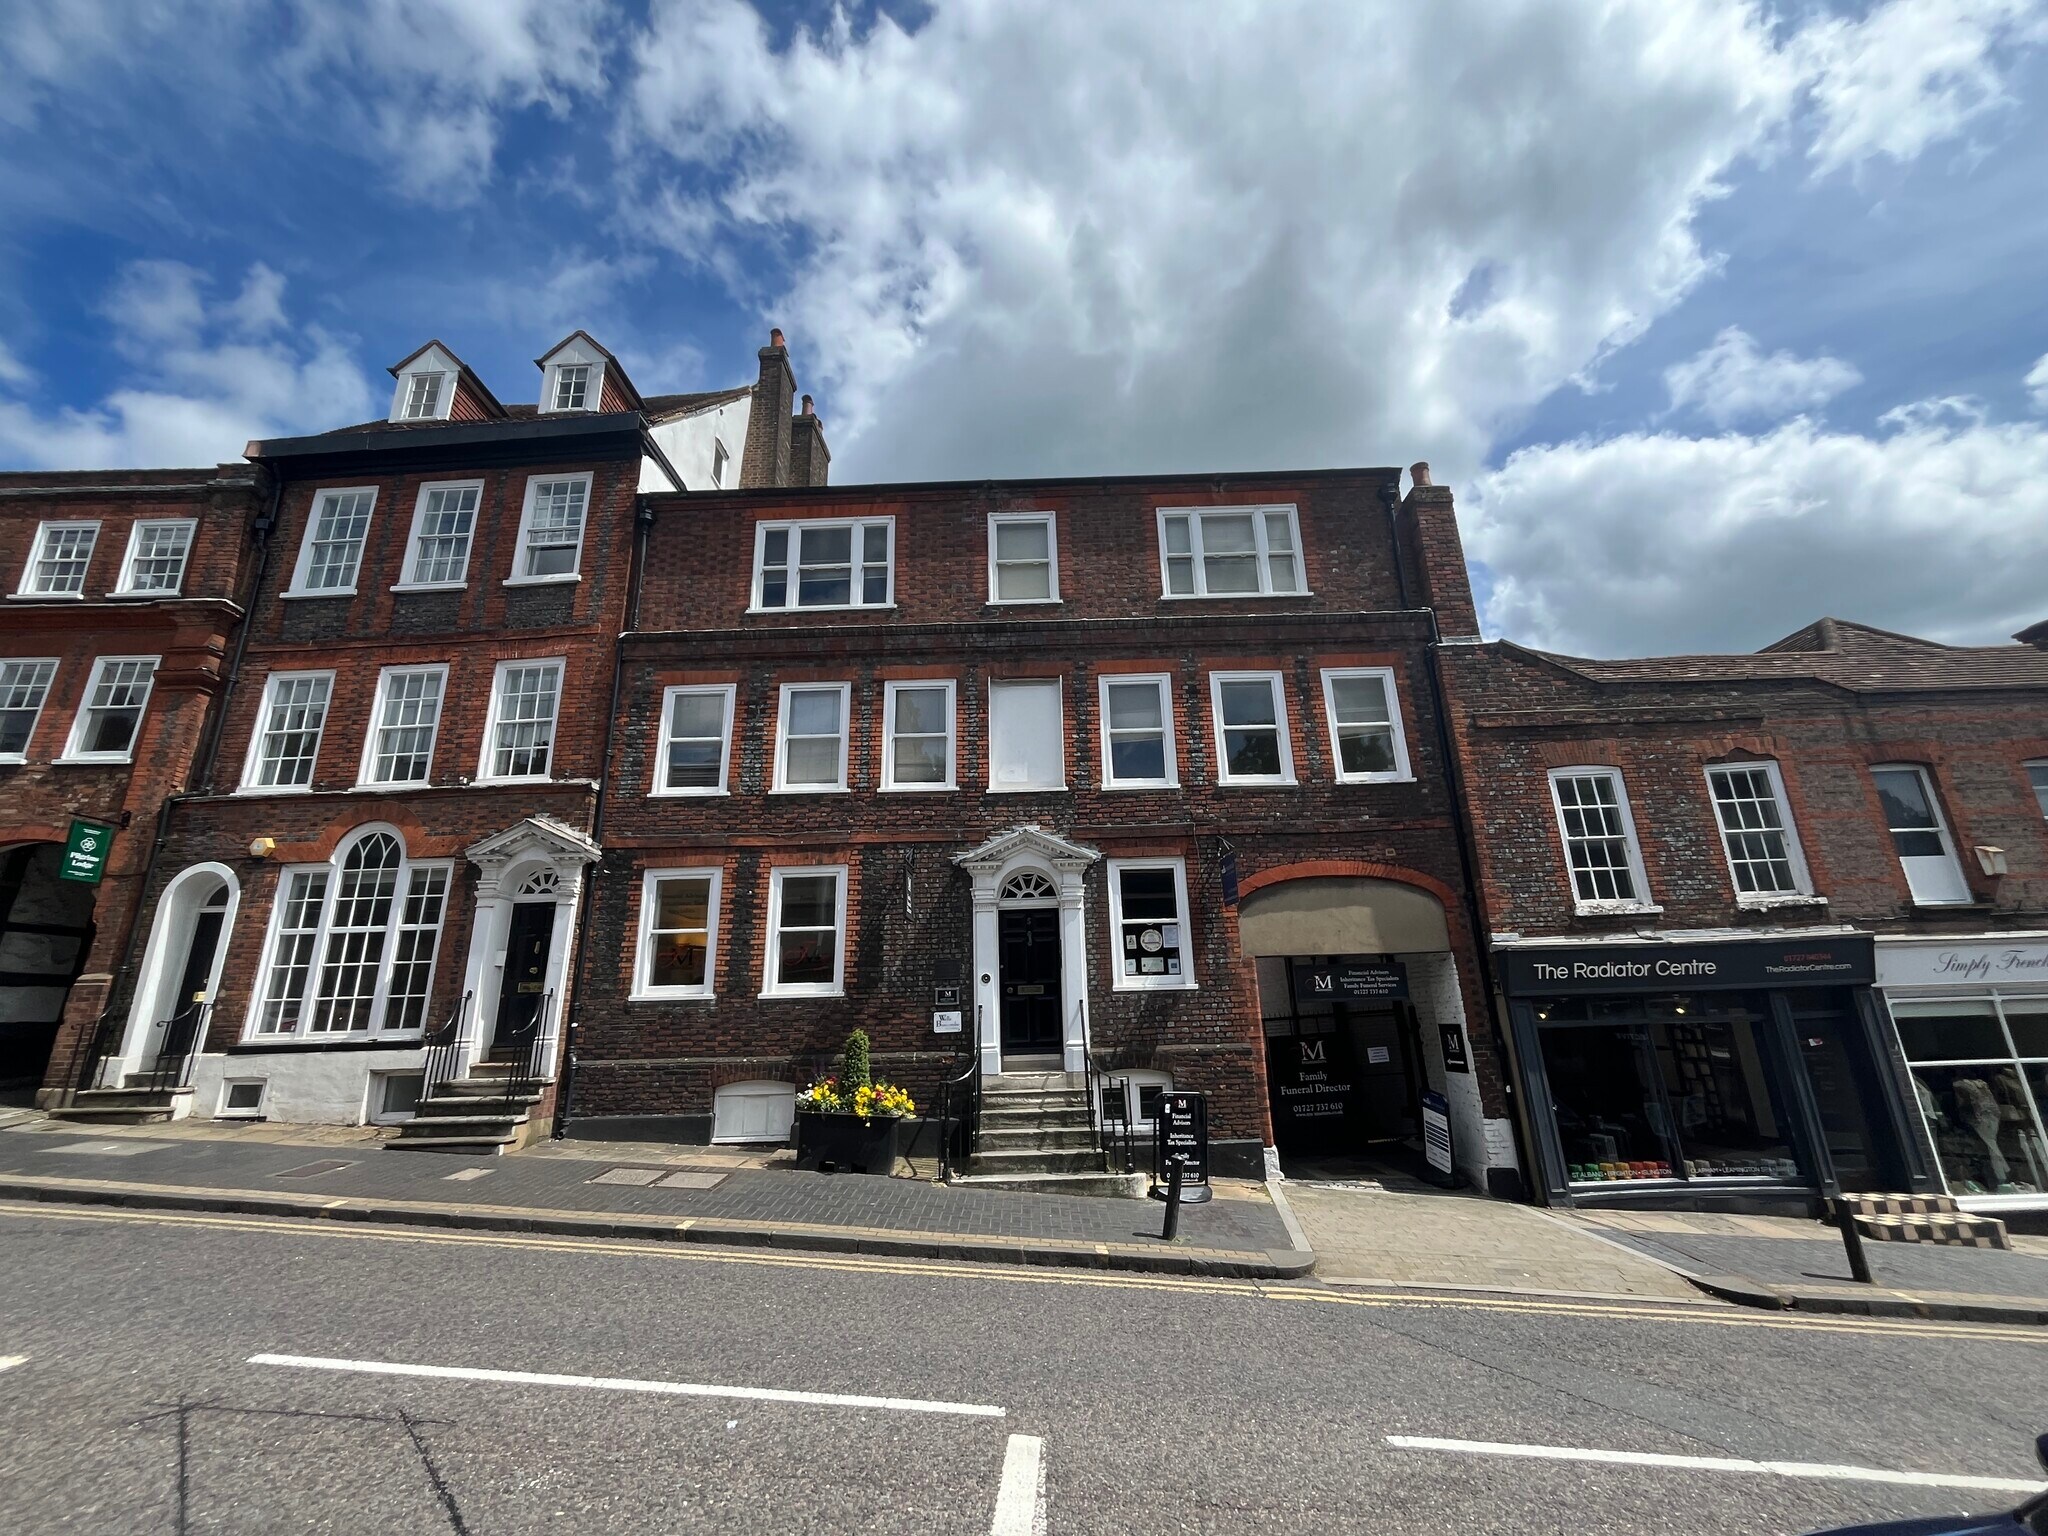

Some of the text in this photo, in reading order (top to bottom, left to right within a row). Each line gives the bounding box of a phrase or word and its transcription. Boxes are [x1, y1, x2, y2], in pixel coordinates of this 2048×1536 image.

[1533, 959, 1717, 980] The Radiator Centre
[1765, 963, 1852, 973] TheRadiatorCentre.com
[1933, 951, 1990, 979] Simply
[1314, 975, 1332, 989] M
[1447, 1034, 1459, 1050] M
[1300, 1040, 1327, 1060] M
[1299, 1071, 1328, 1081] Family
[1280, 1083, 1351, 1096] Funeral Director
[1293, 1102, 1343, 1112] 01727 737 610
[1607, 1169, 1638, 1177] BRIGHTON
[1642, 1168, 1673, 1176] ISLINGTON
